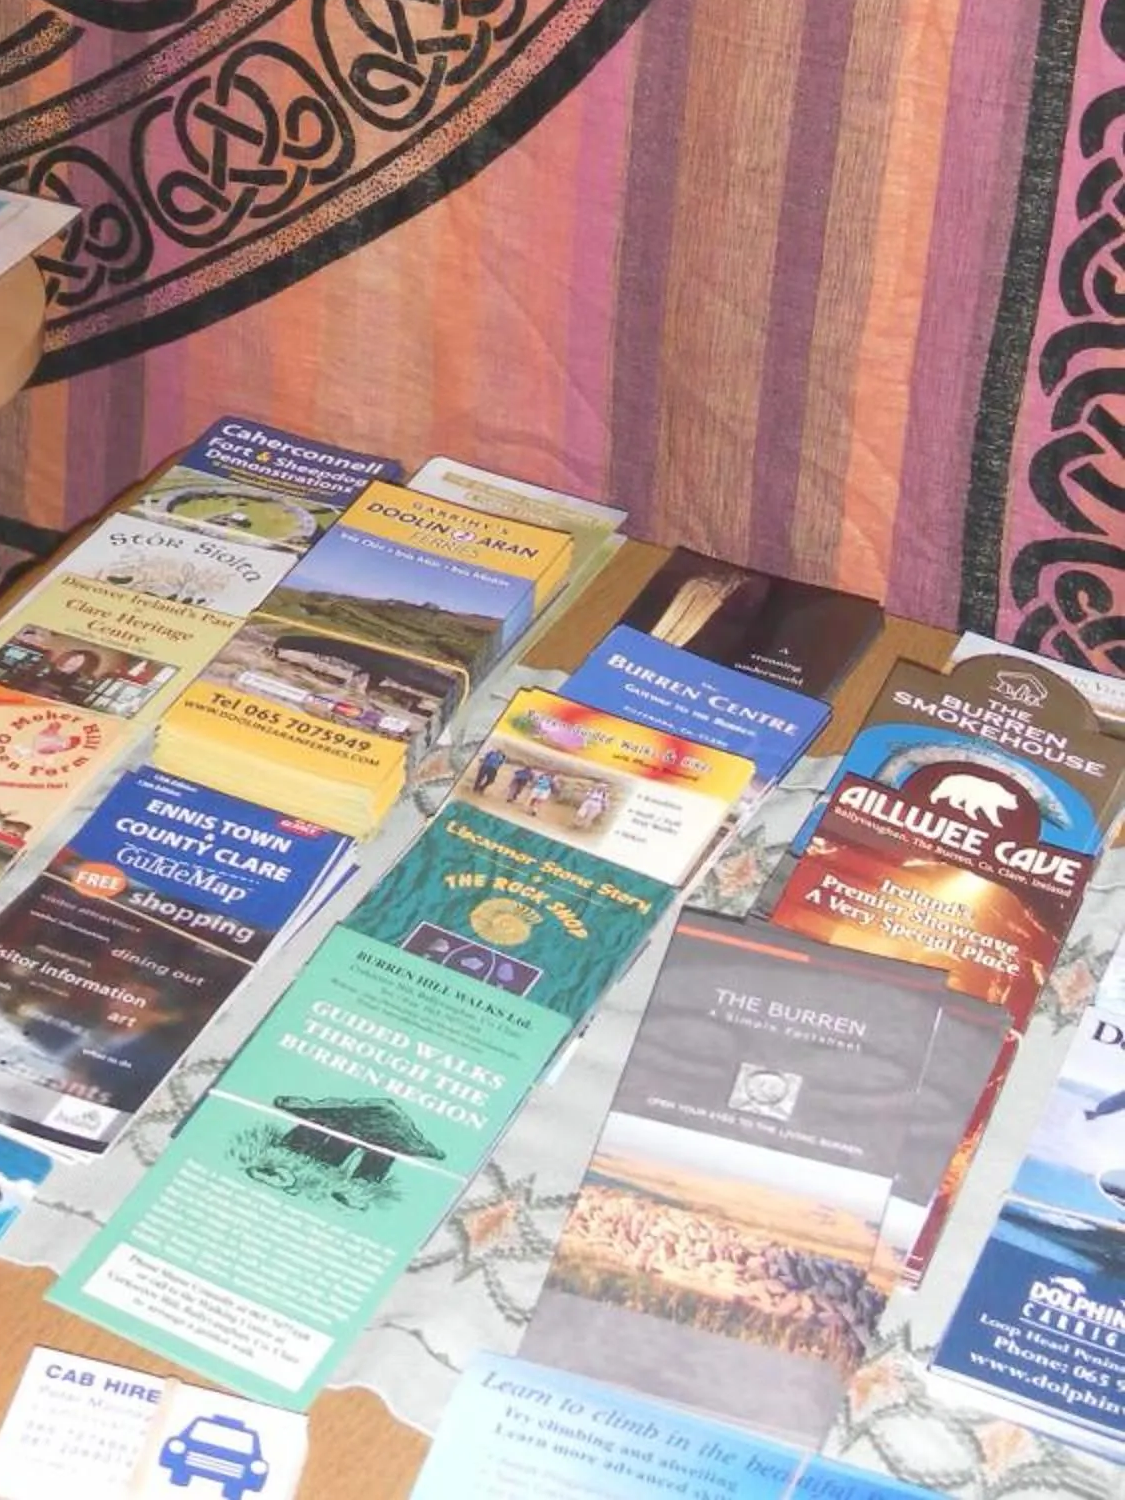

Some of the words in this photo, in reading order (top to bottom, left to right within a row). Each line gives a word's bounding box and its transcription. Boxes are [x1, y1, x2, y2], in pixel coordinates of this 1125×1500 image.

[205, 449, 352, 493] Demonstrations
[208, 437, 253, 457] Fort
[256, 451, 272, 462] &
[274, 456, 368, 487] Sheepdog
[223, 424, 384, 475] Caherconnell
[366, 502, 451, 534] DOOLIN
[477, 538, 538, 560] ARAN
[61, 575, 124, 600] Discover
[131, 594, 196, 619] Ireland's
[202, 613, 236, 629] Past
[65, 599, 113, 618] Clare
[117, 613, 194, 642] Heritage
[87, 619, 148, 644] Centre
[11, 710, 85, 730] Moher
[607, 653, 702, 700] BURREN
[708, 695, 799, 737] CENTRE
[988, 698, 1034, 723] THE
[211, 693, 242, 712] Tel
[243, 701, 279, 724] 065
[286, 715, 372, 753] 7075949
[892, 691, 1107, 778] SMOKEHOUSE
[940, 694, 1068, 749] BURREN
[29, 756, 90, 777] Farm
[115, 817, 214, 857] COUNTY
[214, 849, 292, 883] CLARE
[145, 798, 218, 831] ENNIS
[220, 819, 293, 853] TOWN
[203, 833, 216, 842] &
[838, 786, 990, 856] AILLWEE
[994, 842, 1082, 886] CAVE
[912, 837, 933, 851] The
[978, 859, 994, 872] Co.
[74, 870, 120, 890] FREE
[540, 861, 595, 889] Stone
[596, 883, 652, 915] Story
[821, 874, 904, 917] Premier
[879, 880, 973, 921] Ireland's
[128, 889, 256, 944] shopping
[444, 873, 488, 889] THE
[492, 876, 550, 904] ROCK
[546, 901, 588, 940] SHOP
[804, 889, 821, 905] A
[826, 895, 875, 925] Very
[879, 914, 957, 957] Special
[961, 943, 1021, 976] Place
[40, 961, 148, 1009] information
[110, 946, 171, 976] dining
[172, 971, 207, 989] out
[356, 951, 414, 981] BURREN
[454, 988, 507, 1021] WALKS
[107, 1010, 138, 1028] art
[715, 987, 762, 1013] THE
[768, 1001, 867, 1037] BURREN
[1091, 1020, 1125, 1047] D
[304, 1018, 431, 1083] THROUGH
[431, 1073, 490, 1107] THE
[311, 999, 410, 1048] GUIDED
[415, 1041, 507, 1090] WALKS
[279, 1032, 384, 1088] BURREN
[384, 1077, 489, 1130] REGION
[979, 1312, 1021, 1336] Loop
[1026, 1330, 1070, 1352] Head
[45, 1363, 97, 1388] CAB
[103, 1377, 163, 1404] HIRE
[993, 1335, 1068, 1374] Phone:
[1072, 1365, 1111, 1387] 065
[480, 1370, 554, 1407] Learn
[559, 1396, 585, 1416] to
[591, 1409, 660, 1440] climb
[665, 1430, 691, 1452] in
[697, 1440, 739, 1466] the
[537, 1418, 614, 1453] climbing
[618, 1445, 655, 1463] and
